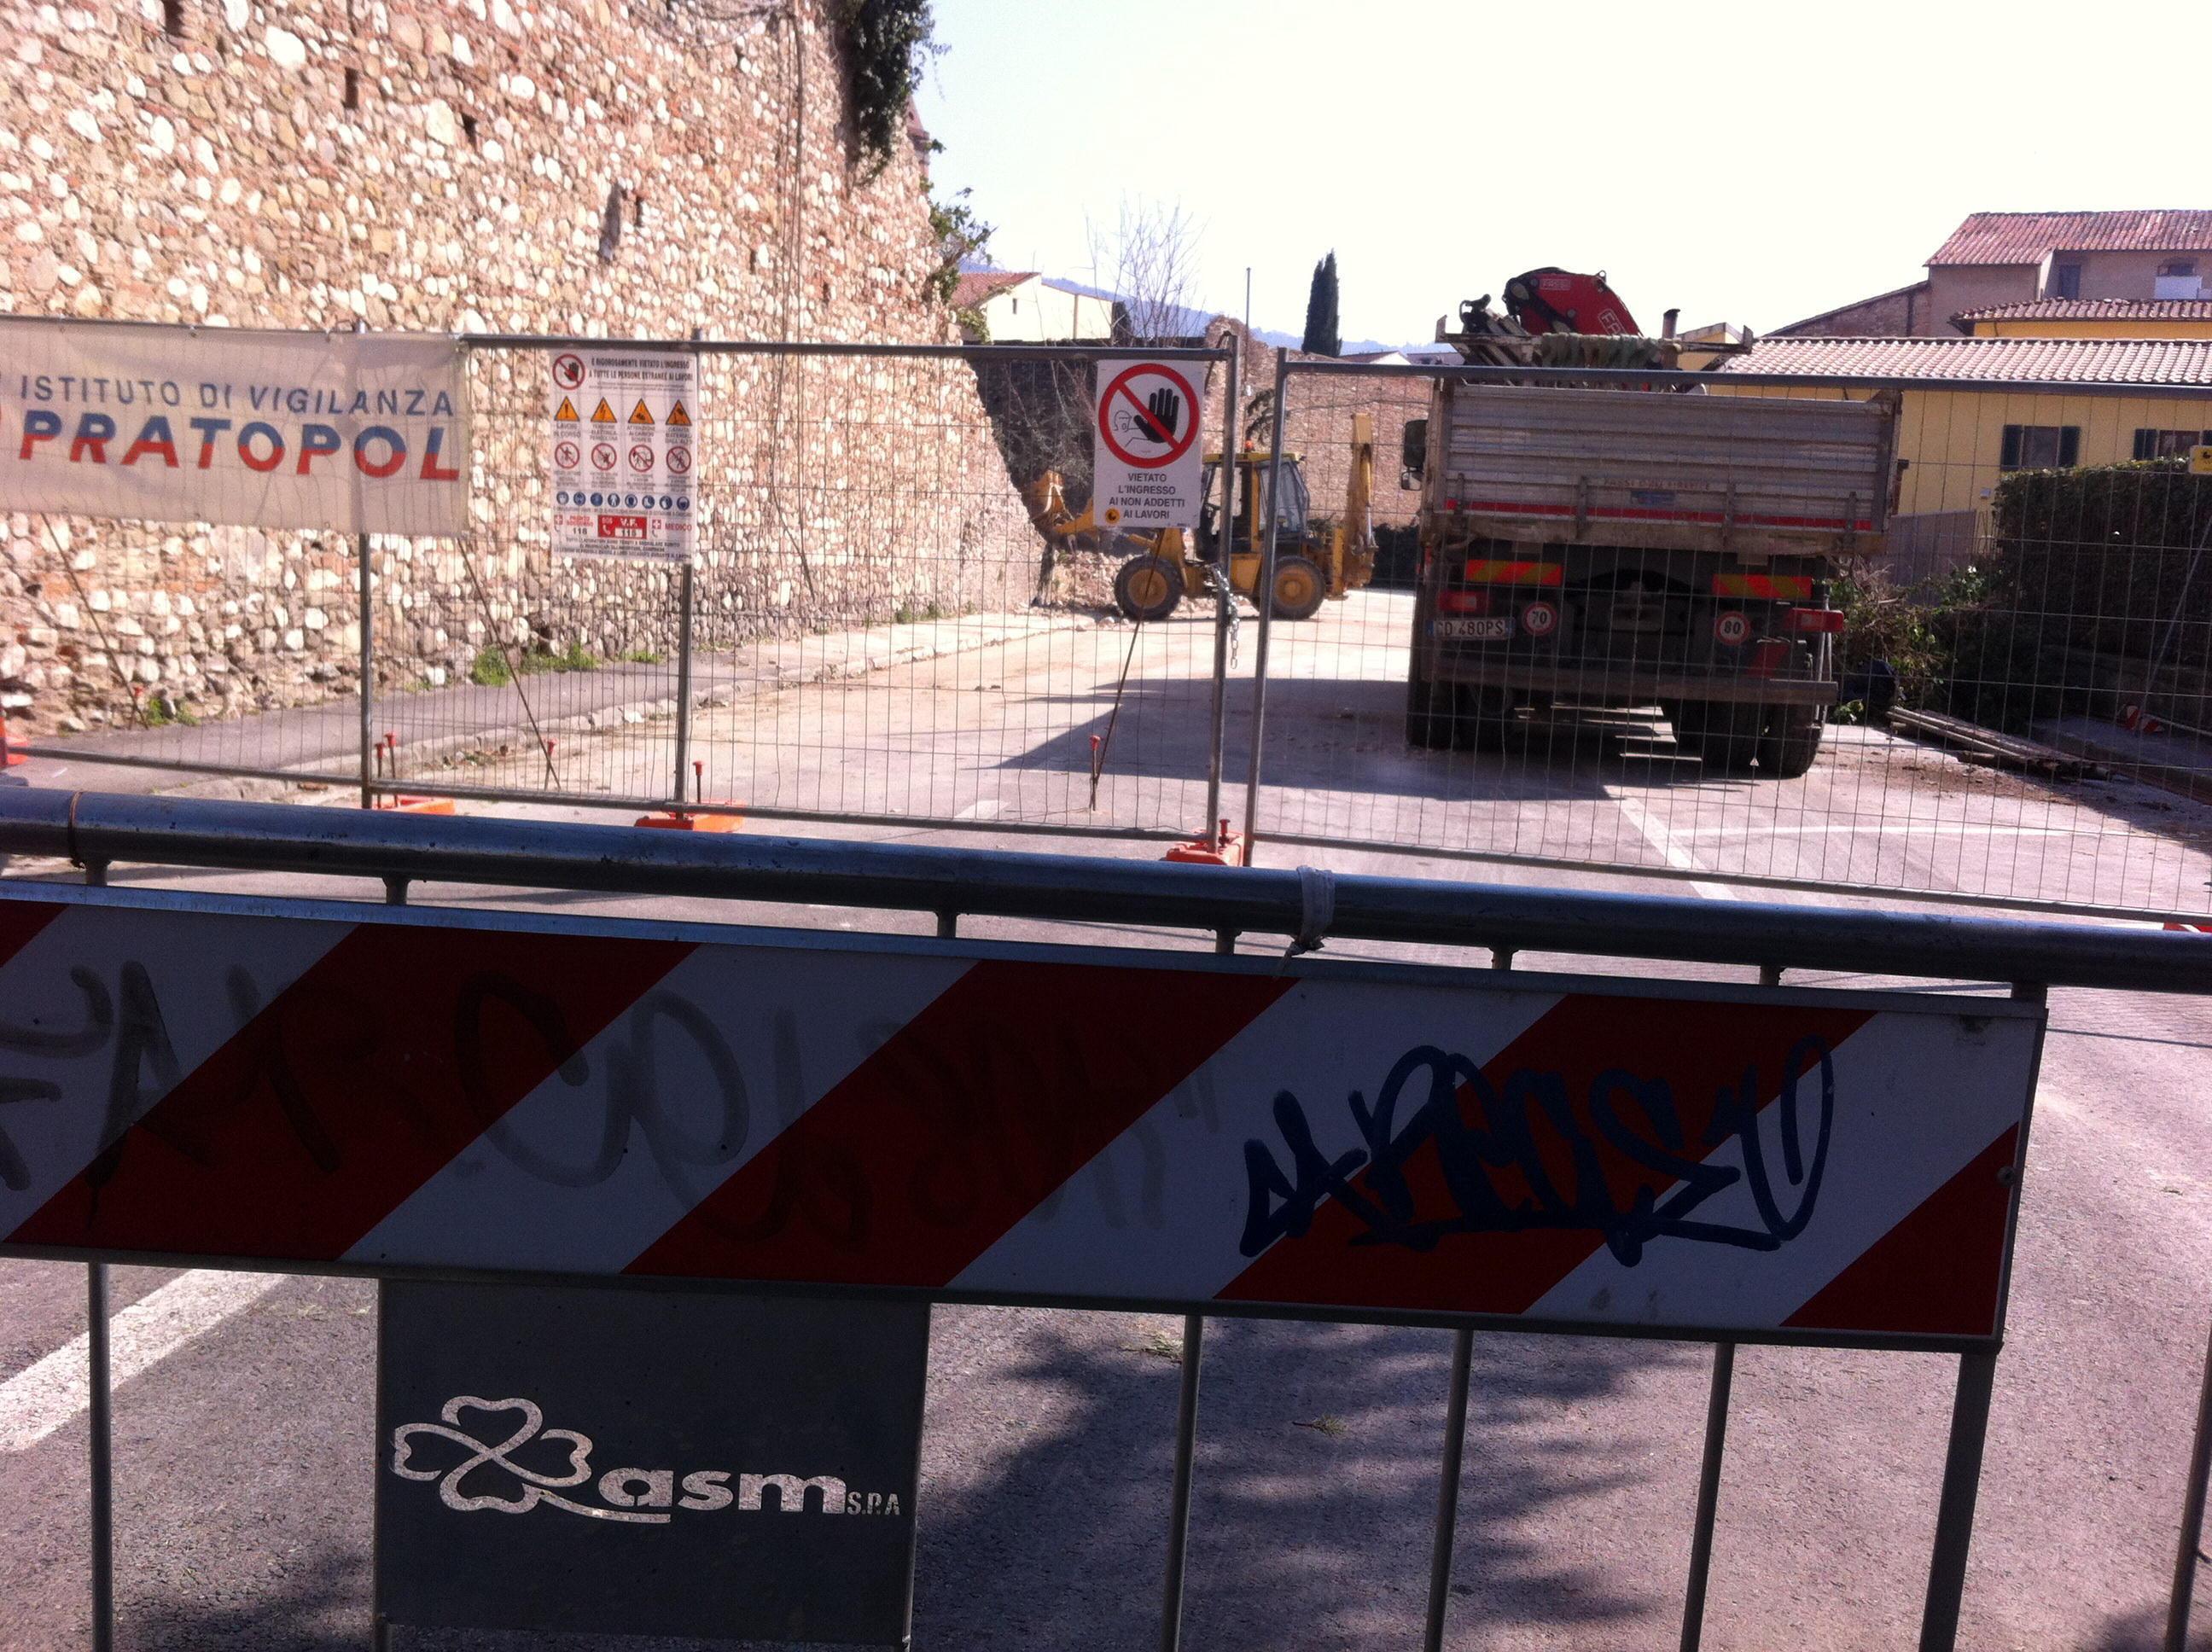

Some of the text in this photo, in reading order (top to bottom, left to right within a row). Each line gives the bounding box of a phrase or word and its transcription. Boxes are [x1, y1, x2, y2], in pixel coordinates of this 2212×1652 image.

[639, 359, 660, 368] VIETATO
[618, 370, 640, 380] PERSONE
[20, 375, 454, 417] ISTITUTO DI VIGILANZA
[19, 410, 459, 480] PRATOPOL
[1128, 474, 1167, 482] VIETATO
[1118, 486, 1176, 495] L'INGRESSO
[1109, 497, 1185, 507] AI NON ADDETTI
[1135, 510, 1170, 519] LAVORI
[1532, 611, 1547, 625] 70
[1724, 620, 1741, 634] 80
[597, 1467, 847, 1514] asm
